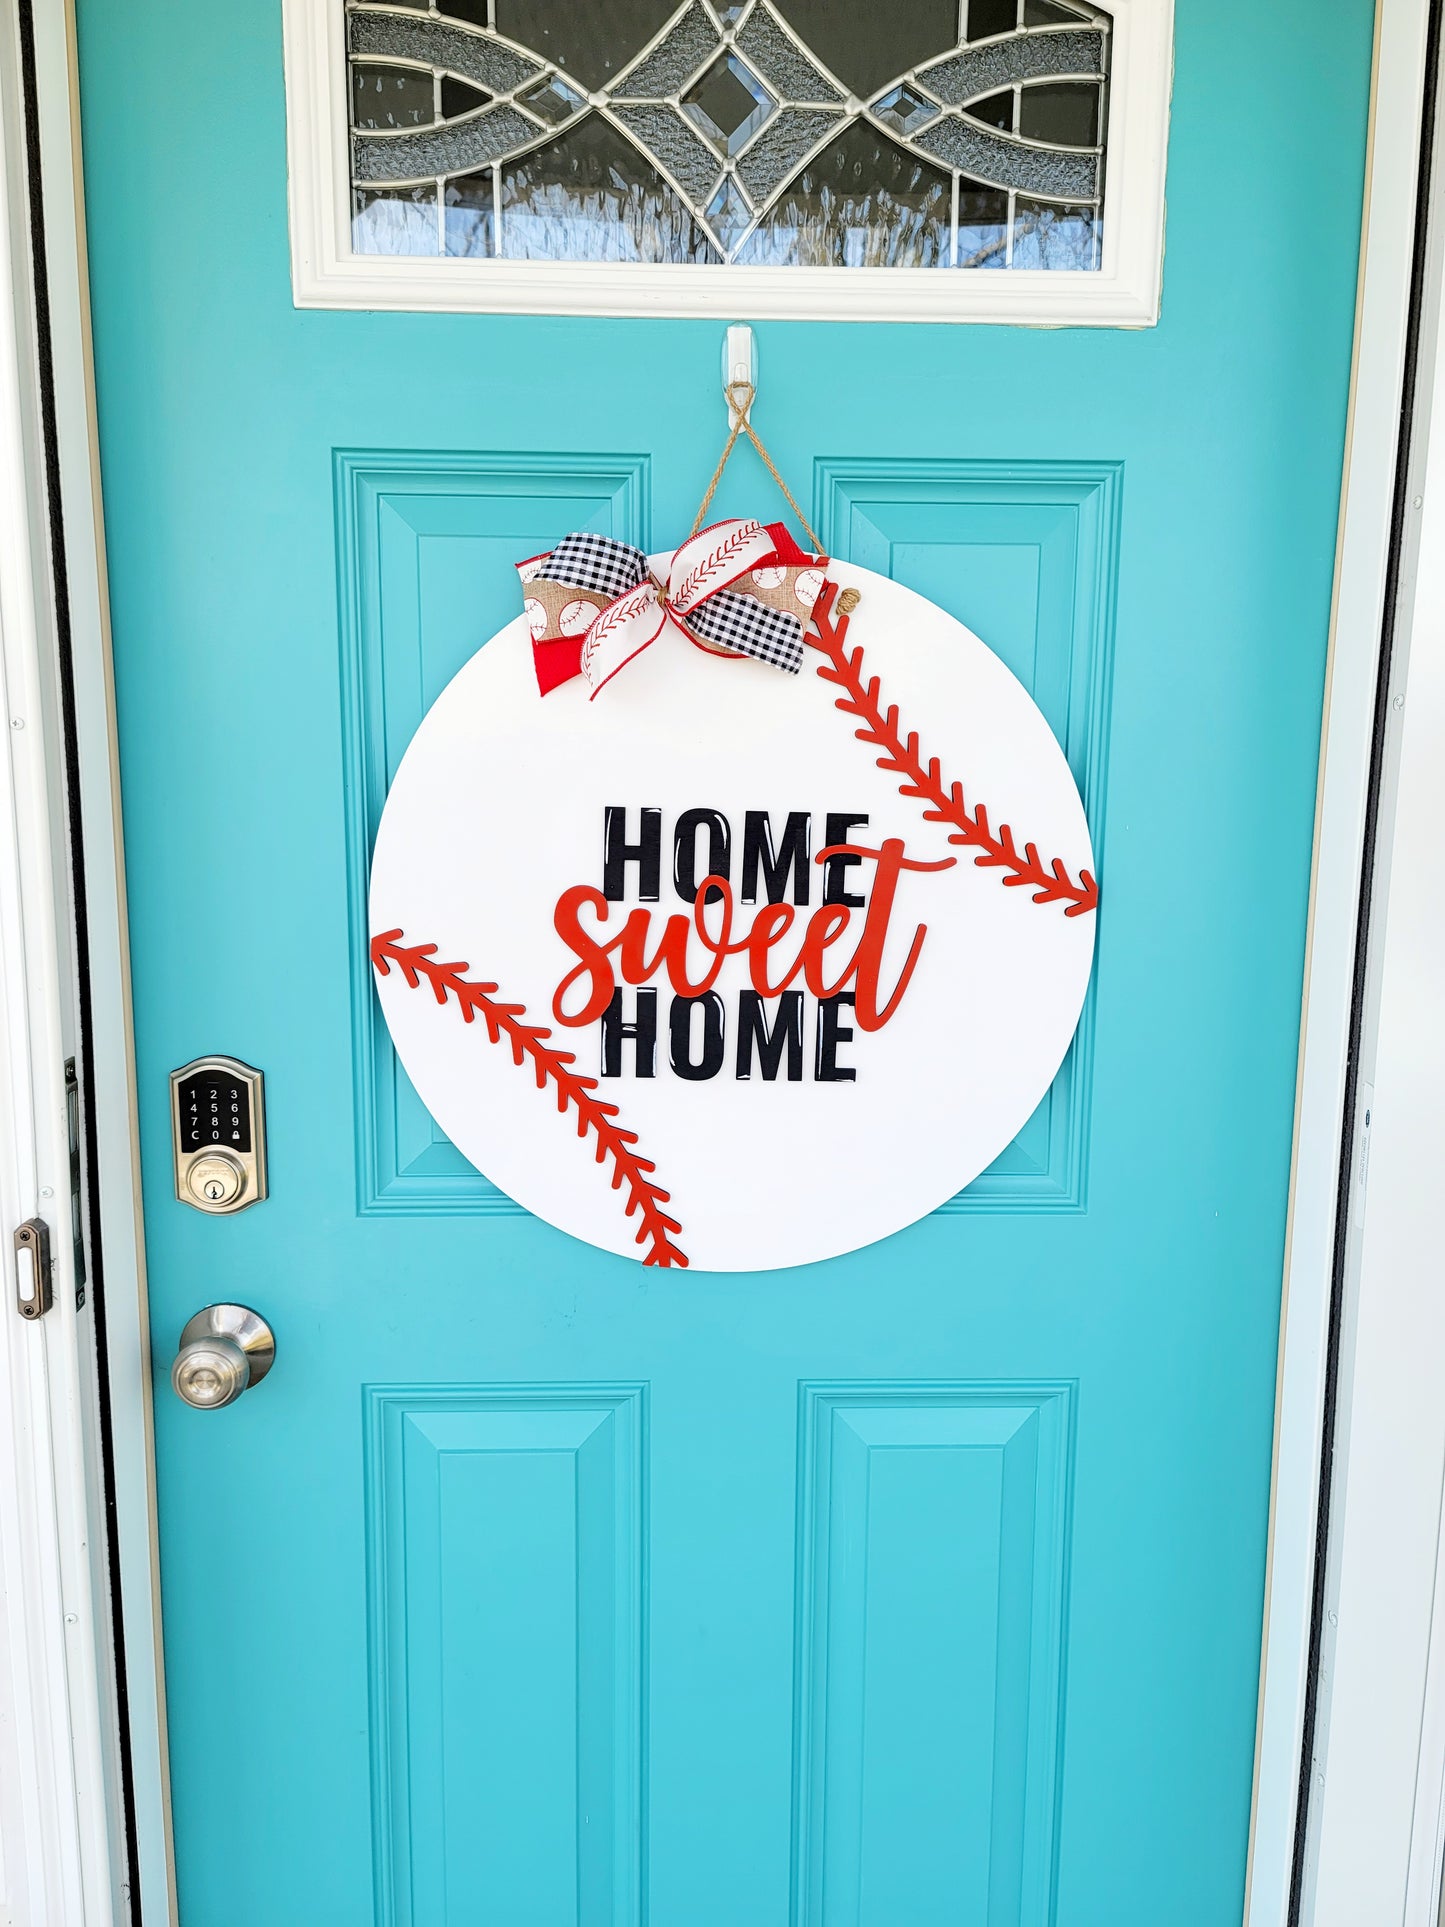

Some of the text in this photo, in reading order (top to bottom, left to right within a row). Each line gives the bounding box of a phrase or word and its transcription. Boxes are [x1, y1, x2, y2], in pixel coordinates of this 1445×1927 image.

[603, 806, 869, 908] HOME
[552, 838, 957, 1032] sweet
[601, 986, 857, 1082] HOME
[190, 1090, 238, 1099] 1 2 3
[190, 1104, 239, 1112] 4 5 6
[191, 1117, 239, 1126] 7 8 9
[191, 1130, 199, 1139] C
